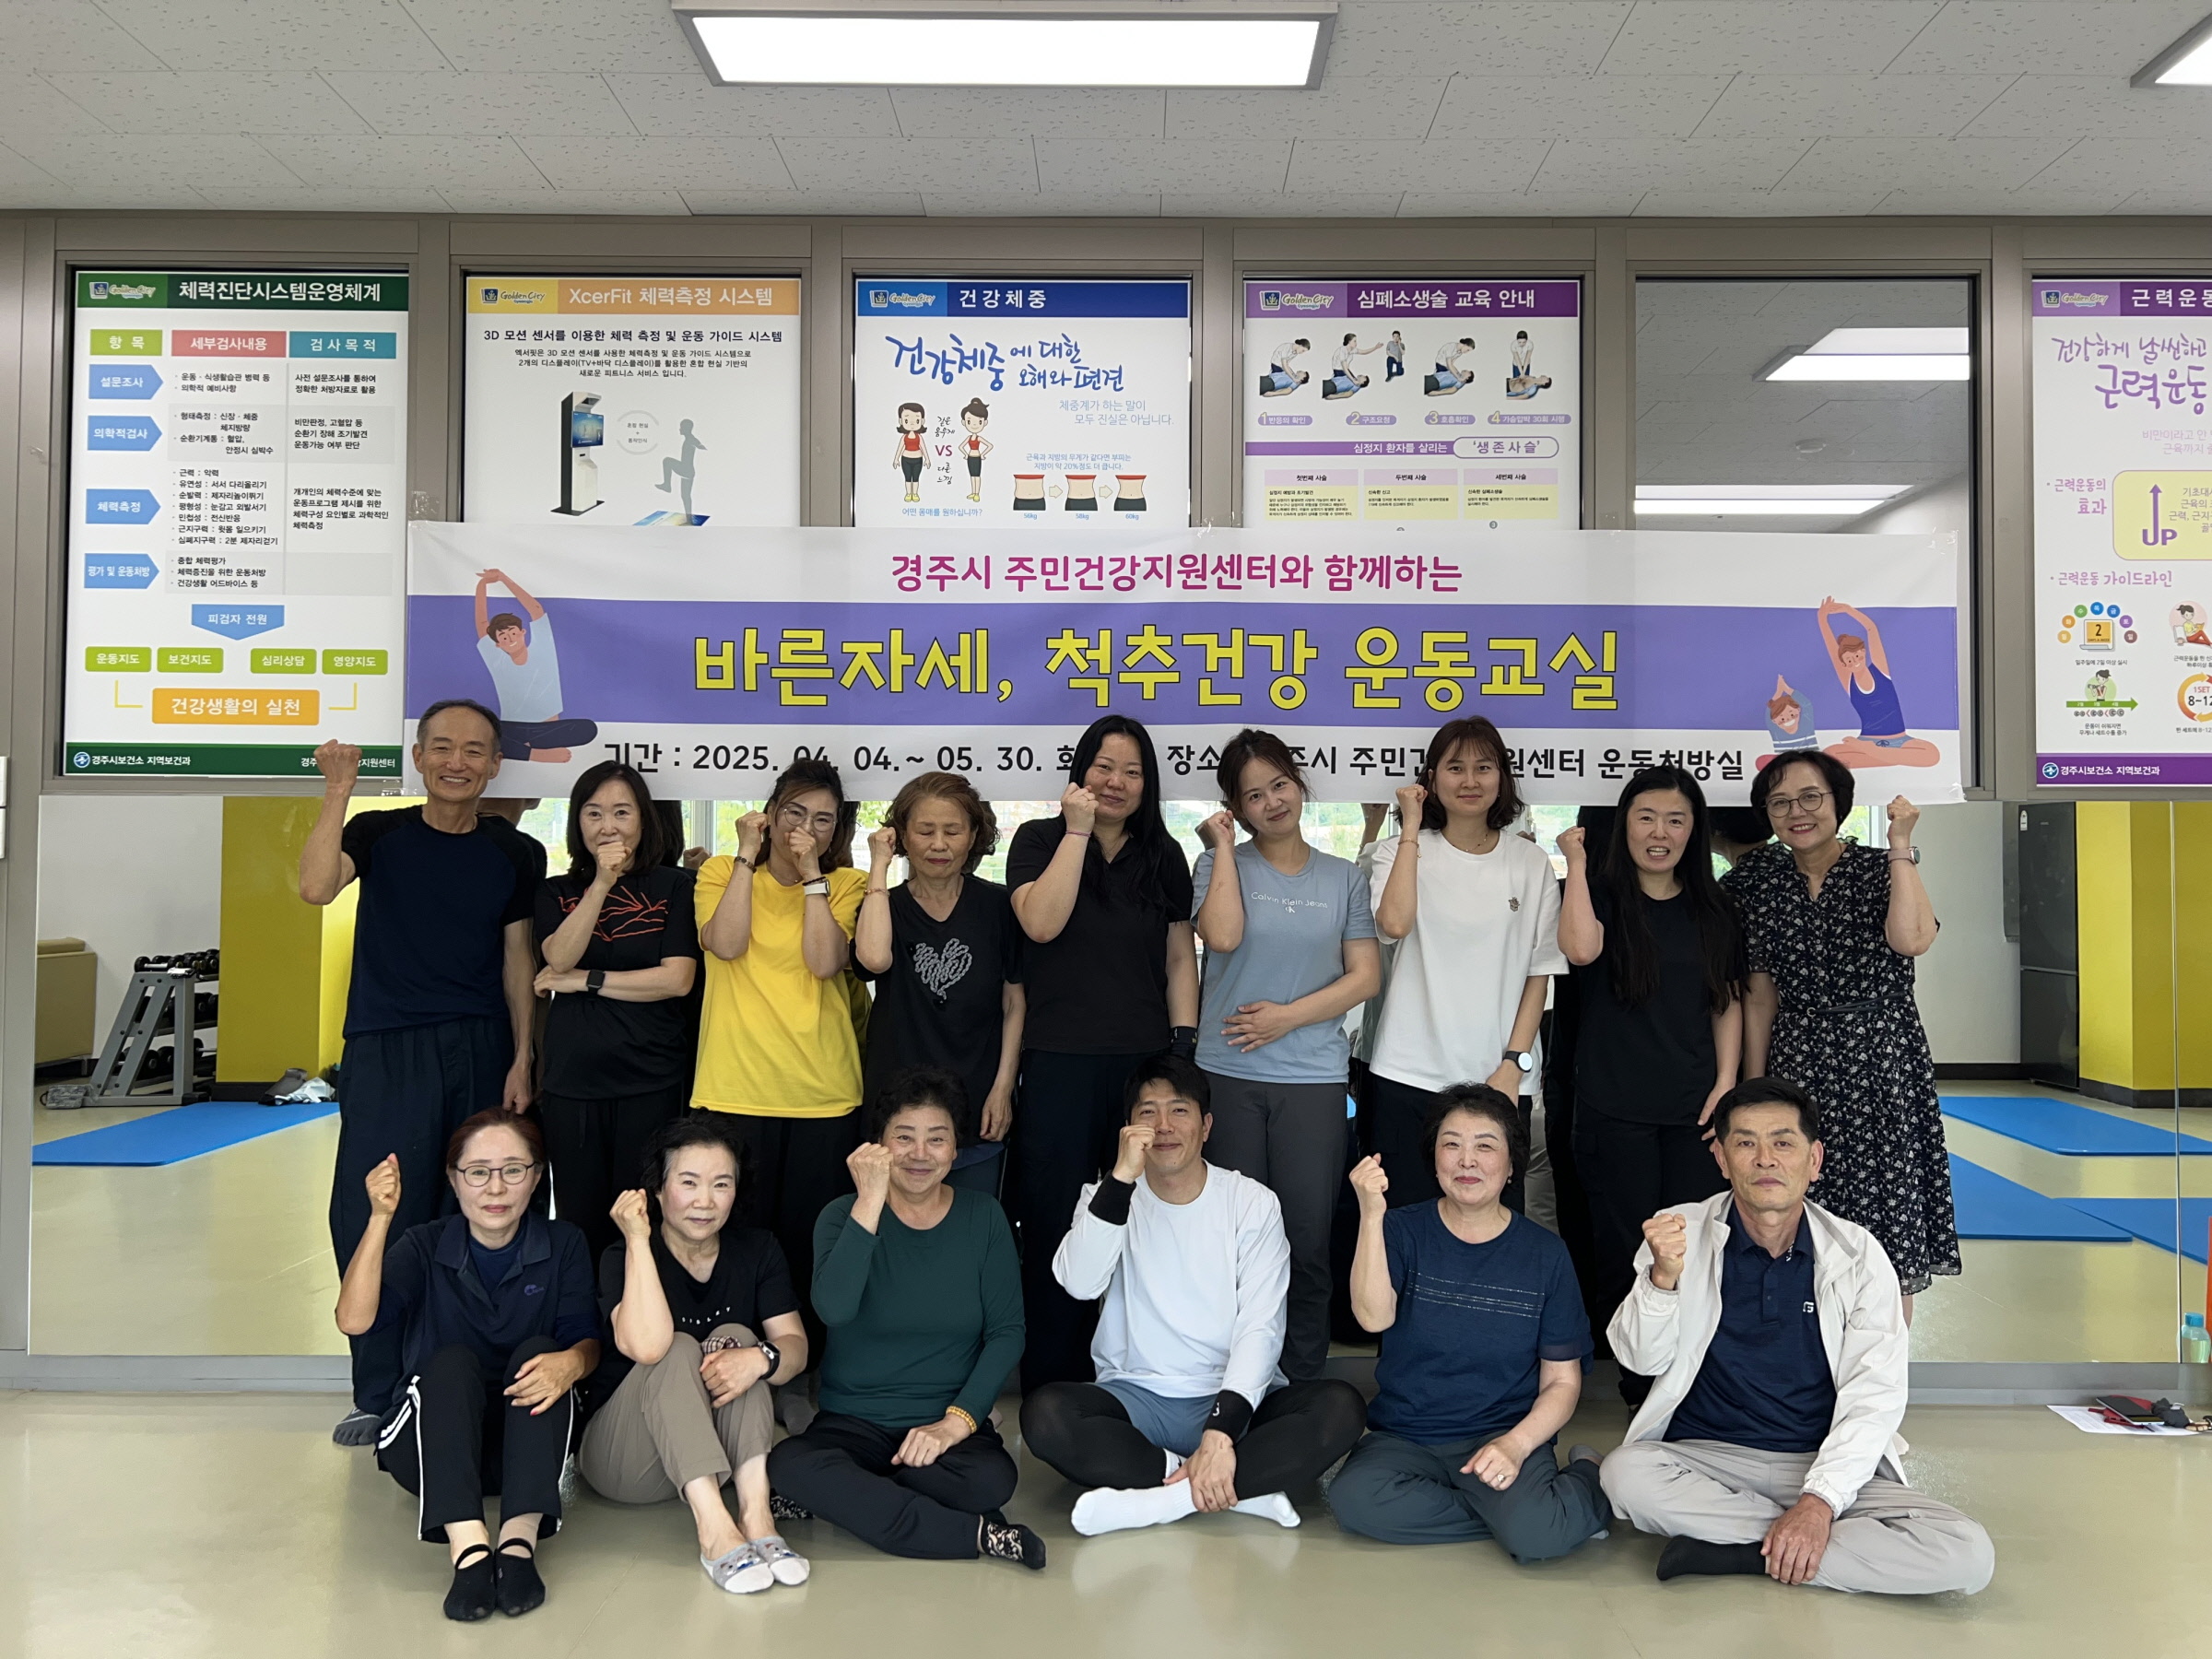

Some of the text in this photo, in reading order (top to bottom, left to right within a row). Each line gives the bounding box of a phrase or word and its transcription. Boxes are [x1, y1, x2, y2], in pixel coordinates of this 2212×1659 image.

[179, 280, 382, 302] 체력진단시스템운영체계
[569, 287, 772, 307] XcerFit 체력측정 시스템
[1358, 289, 1535, 309] 심폐소생술 교육 안내
[484, 329, 782, 343] 3D 모션 센서를 이용한 체력 측정 및 운동 가이드 시스템
[191, 336, 267, 351] 세부검사내용
[1039, 334, 1081, 364] 대한
[2052, 332, 2207, 365] 건강하게 날씬하고
[295, 373, 311, 382] 사전
[637, 370, 659, 378] 서비스
[100, 376, 144, 388] 설문조사
[2094, 363, 2207, 415] 근력운동
[1059, 399, 1146, 412] 체중계가 하는 말이
[1074, 413, 1174, 426] 모두 진실은 아닙니다.
[1350, 411, 1360, 425] 2
[1429, 410, 1439, 424] 3
[1491, 410, 1500, 424] 4
[93, 427, 148, 440] 의학적검사
[2142, 429, 2194, 441] 비만이라고
[935, 444, 953, 457] VS
[1353, 442, 1382, 453] 심정지
[1385, 442, 1416, 453] 환자를
[1418, 442, 1448, 453] 살리는
[2054, 478, 2106, 492] 근력운동의
[97, 500, 141, 513] 체력측정
[2077, 498, 2107, 515] 효과
[891, 553, 1463, 593] 경주시 주민건강지원센터와 함께하는
[2058, 570, 2173, 588] 근력운동 가이드라인
[207, 613, 268, 626] 피검자 전원
[2095, 623, 2102, 637] 2
[96, 653, 140, 665] 운동지도
[168, 653, 212, 666] 보건지도
[262, 654, 305, 667] 심리상담
[333, 655, 376, 668] 영양지도
[694, 624, 1619, 712] 바른자세, 척추건강 운동교실
[171, 697, 300, 717] 건강생활의 실천
[91, 756, 191, 766] 경주시보건소 지역보건과
[692, 744, 779, 771] 2025.
[936, 745, 983, 772] 05.
[996, 745, 1042, 772] 30.
[2060, 766, 2160, 776] 경주시보건소 지역보건과
[1251, 891, 1328, 910] Calvin Klein Jeans
